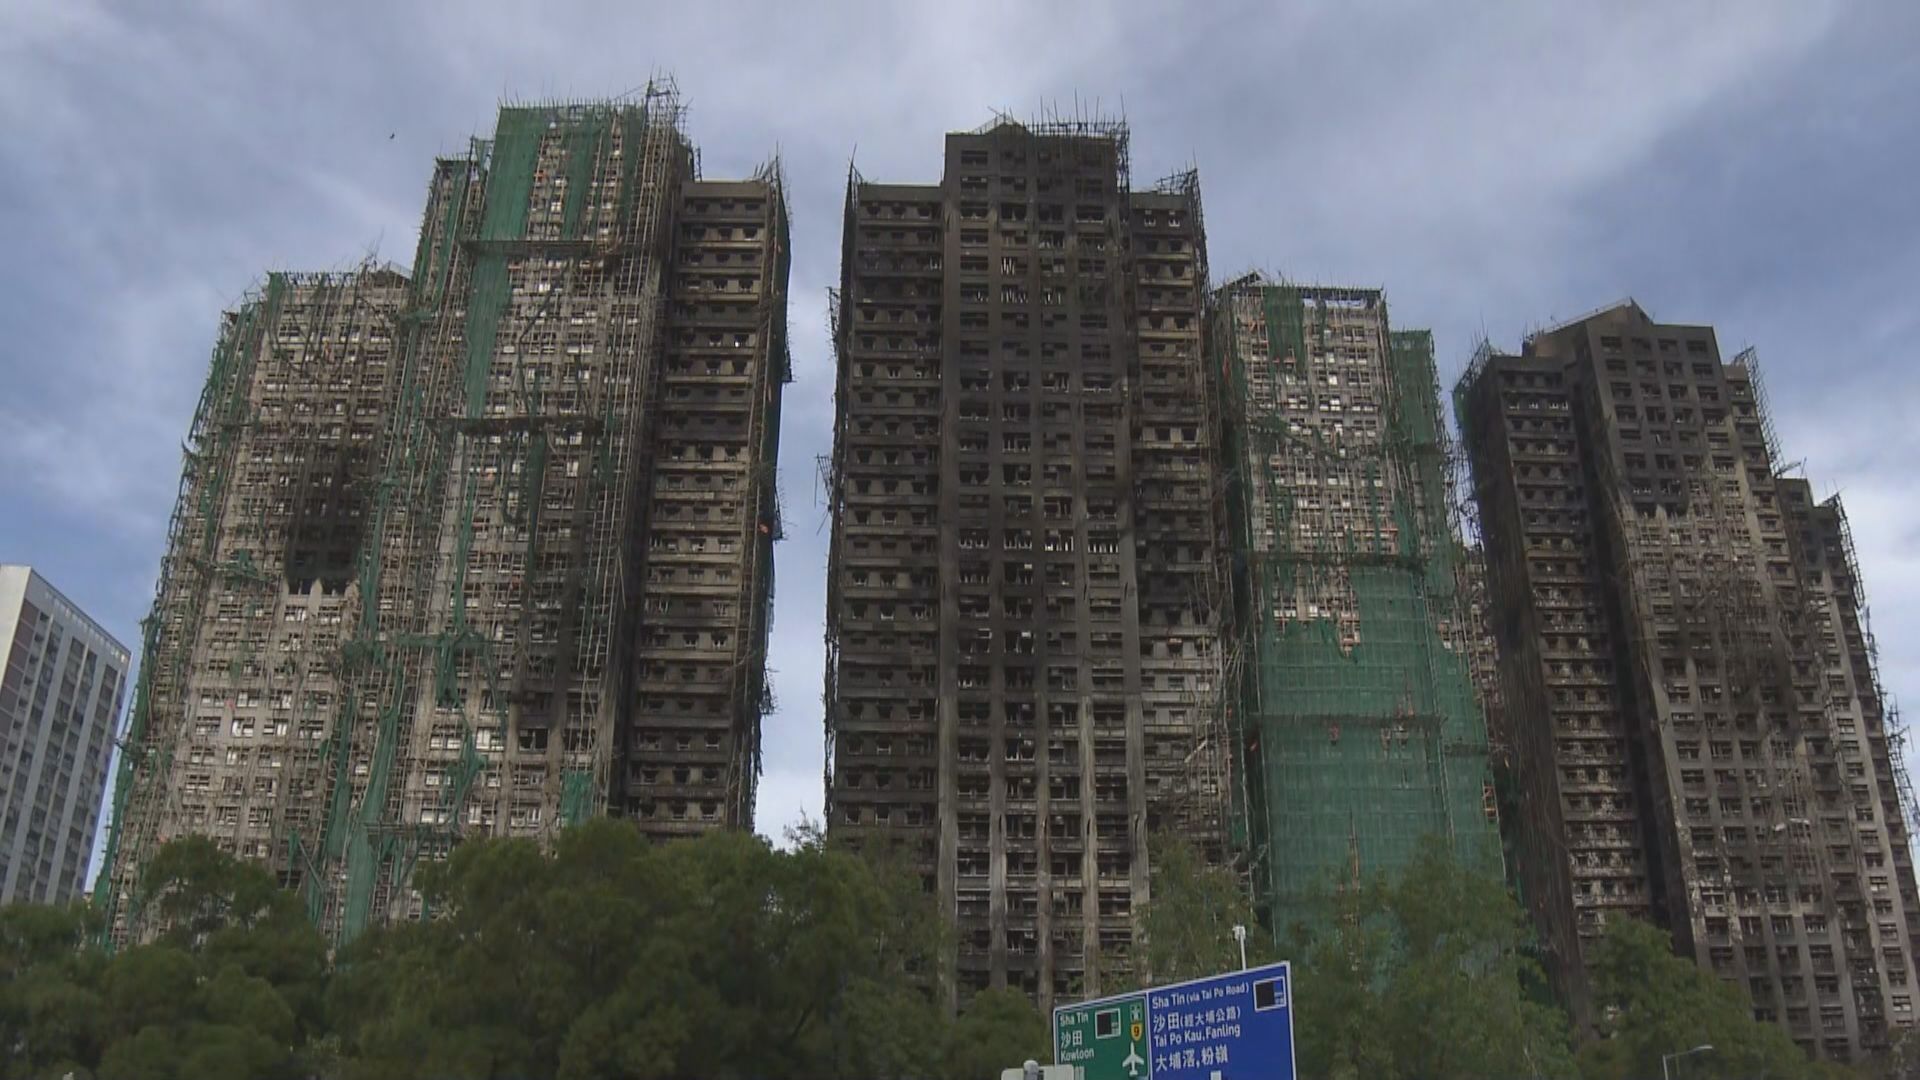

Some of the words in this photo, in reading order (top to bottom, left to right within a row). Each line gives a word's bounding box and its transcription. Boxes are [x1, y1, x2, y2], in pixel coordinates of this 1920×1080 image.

[1152, 996, 1169, 1009] Sha
[1172, 993, 1185, 1006] Tin
[1201, 989, 1212, 1000] Tai
[1214, 988, 1224, 998] Po
[1059, 1013, 1075, 1027] Sha
[1076, 1011, 1089, 1024] Tin
[1061, 1030, 1083, 1049] 沙田
[1154, 1034, 1167, 1048] Tai
[1170, 1032, 1182, 1045] Po
[1061, 1048, 1095, 1062] Kowloon
